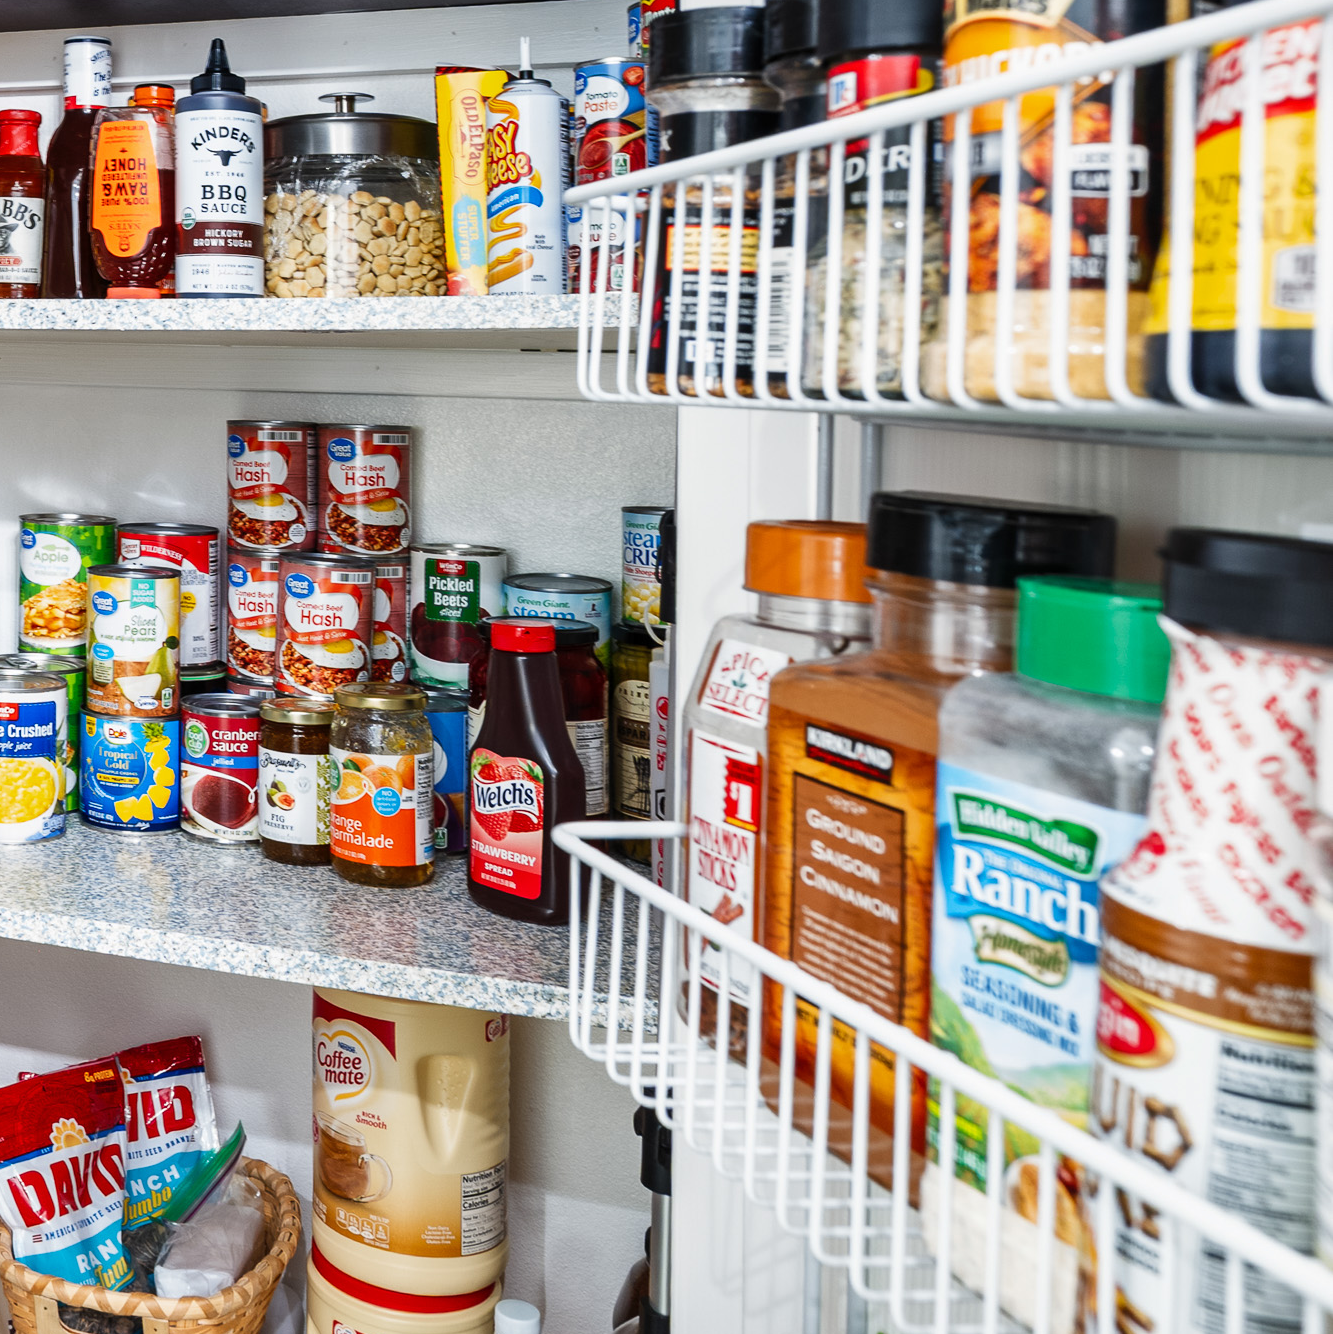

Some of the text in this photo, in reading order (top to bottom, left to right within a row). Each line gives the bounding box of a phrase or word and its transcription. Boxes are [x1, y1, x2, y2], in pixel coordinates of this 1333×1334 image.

[584, 90, 619, 102] Tomato
[583, 100, 619, 114] Paste
[190, 126, 256, 154] KINDER'S
[102, 157, 147, 173] HONEY
[200, 184, 248, 204] BBQ
[200, 203, 248, 215] SAUCE
[467, 204, 480, 242] SUPER
[193, 238, 254, 249] BROWN SUGAR
[204, 229, 244, 240] HICKORY
[457, 212, 472, 263] STUFFER
[234, 465, 271, 483] Hash
[344, 469, 387, 487] Hash
[32, 549, 69, 565] Apple
[429, 575, 475, 594] Pickled
[237, 596, 274, 614] Hash
[433, 591, 469, 609] Beets
[130, 614, 157, 629] Sliced
[299, 608, 344, 628] Hash
[123, 624, 157, 637] Pears
[704, 680, 768, 717] SELECT
[7, 718, 53, 737] Crushed
[107, 727, 128, 740] Dole
[212, 740, 249, 752] sauce
[806, 725, 894, 771] KIRKLAND
[104, 759, 130, 771] Gold
[473, 780, 537, 807] Welch's
[271, 813, 286, 823] FIG
[805, 808, 887, 856] GROUND
[957, 797, 1094, 873] Hidden Valley
[471, 841, 537, 867] STRAWBERRY
[810, 840, 882, 884] SAIGON
[484, 865, 514, 878] SPREAD
[697, 848, 738, 892] STICKS
[800, 866, 899, 925] CINNAMON
[950, 844, 1101, 946] Ranch
[316, 1041, 363, 1070] Coffee
[324, 1065, 365, 1087] mate
[355, 1114, 388, 1131] Smooth
[462, 1172, 488, 1184] Nutrition
[122, 1186, 173, 1227] Jumbo
